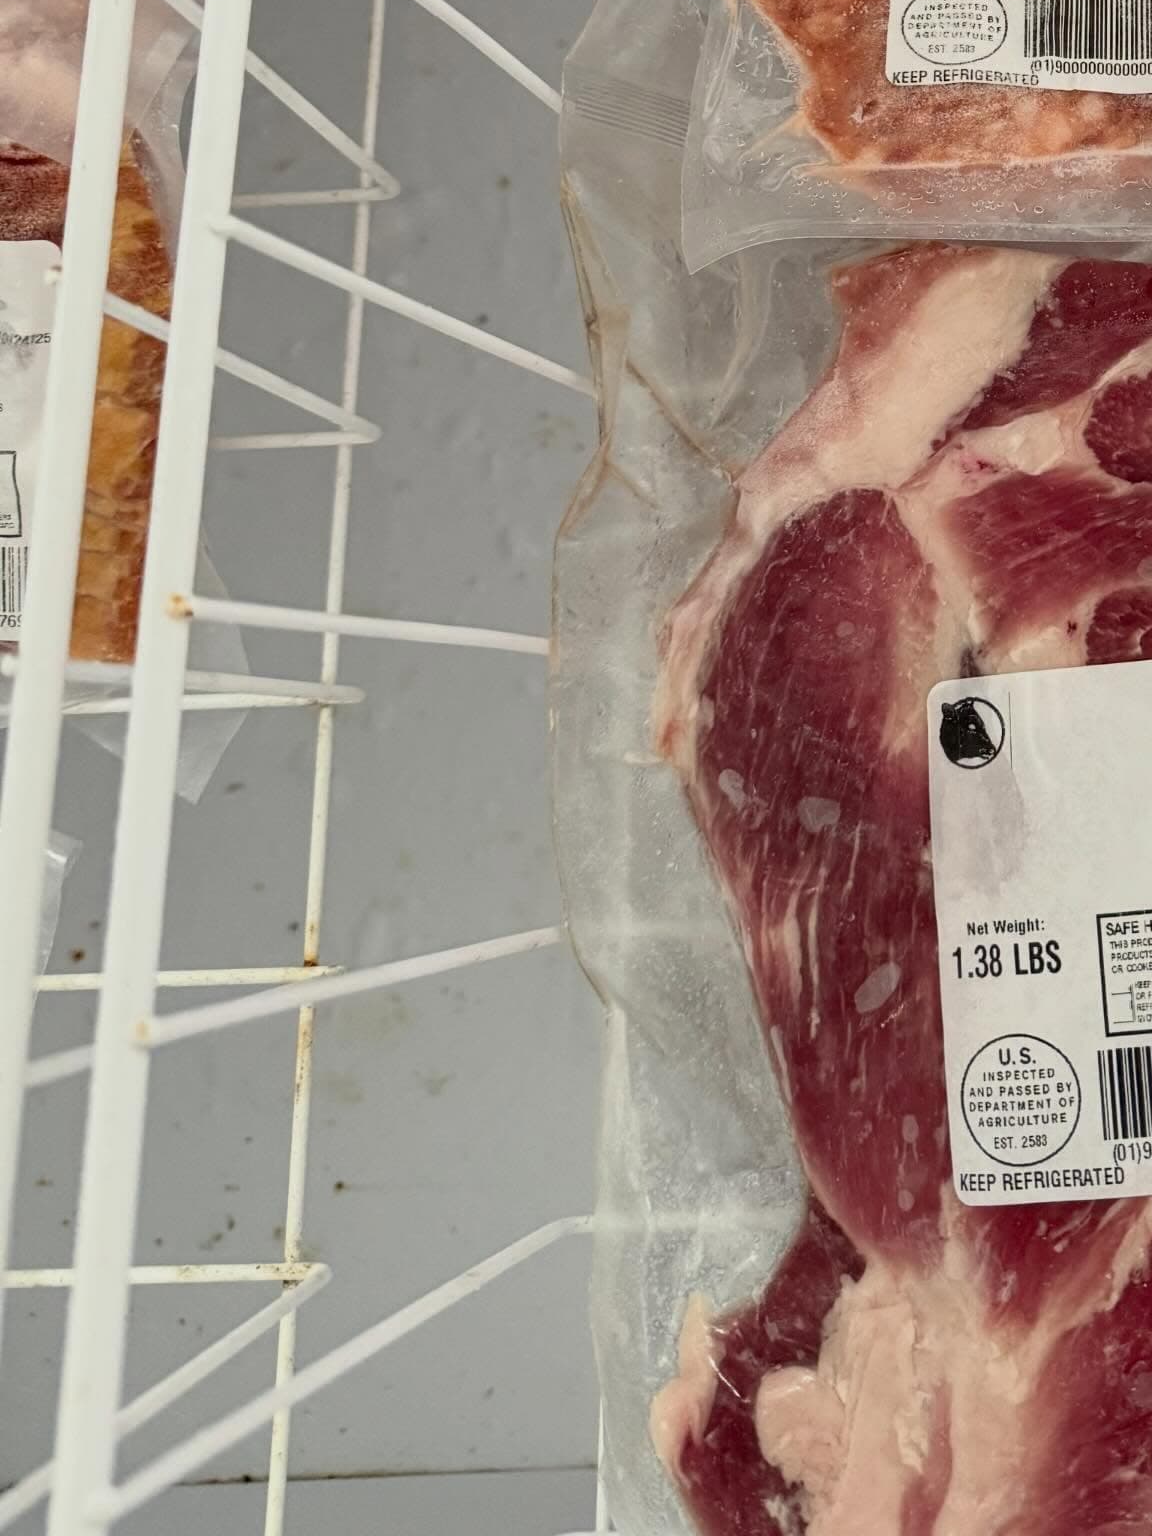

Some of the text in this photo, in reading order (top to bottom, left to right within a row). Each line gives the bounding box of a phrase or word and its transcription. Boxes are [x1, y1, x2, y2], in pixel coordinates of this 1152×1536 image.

[893, 69, 1039, 85] KEEP REFRIGERATED
[967, 919, 1045, 935] Net Weight:
[1106, 920, 1139, 936] SAFE
[953, 940, 1062, 979] 1.38 LBS
[1111, 951, 1152, 961] PRODUCTS
[998, 1047, 1037, 1065] U.S.
[983, 1068, 1055, 1082] INSPECTED
[969, 1082, 1072, 1097] AND PASSED BY
[969, 1097, 1075, 1112] DEPARTMENT OF
[978, 1113, 1067, 1127] AGRICULTURE
[994, 1134, 1048, 1149] EST. 2583
[960, 1166, 1125, 1191] KEEP REFRIGERATED
